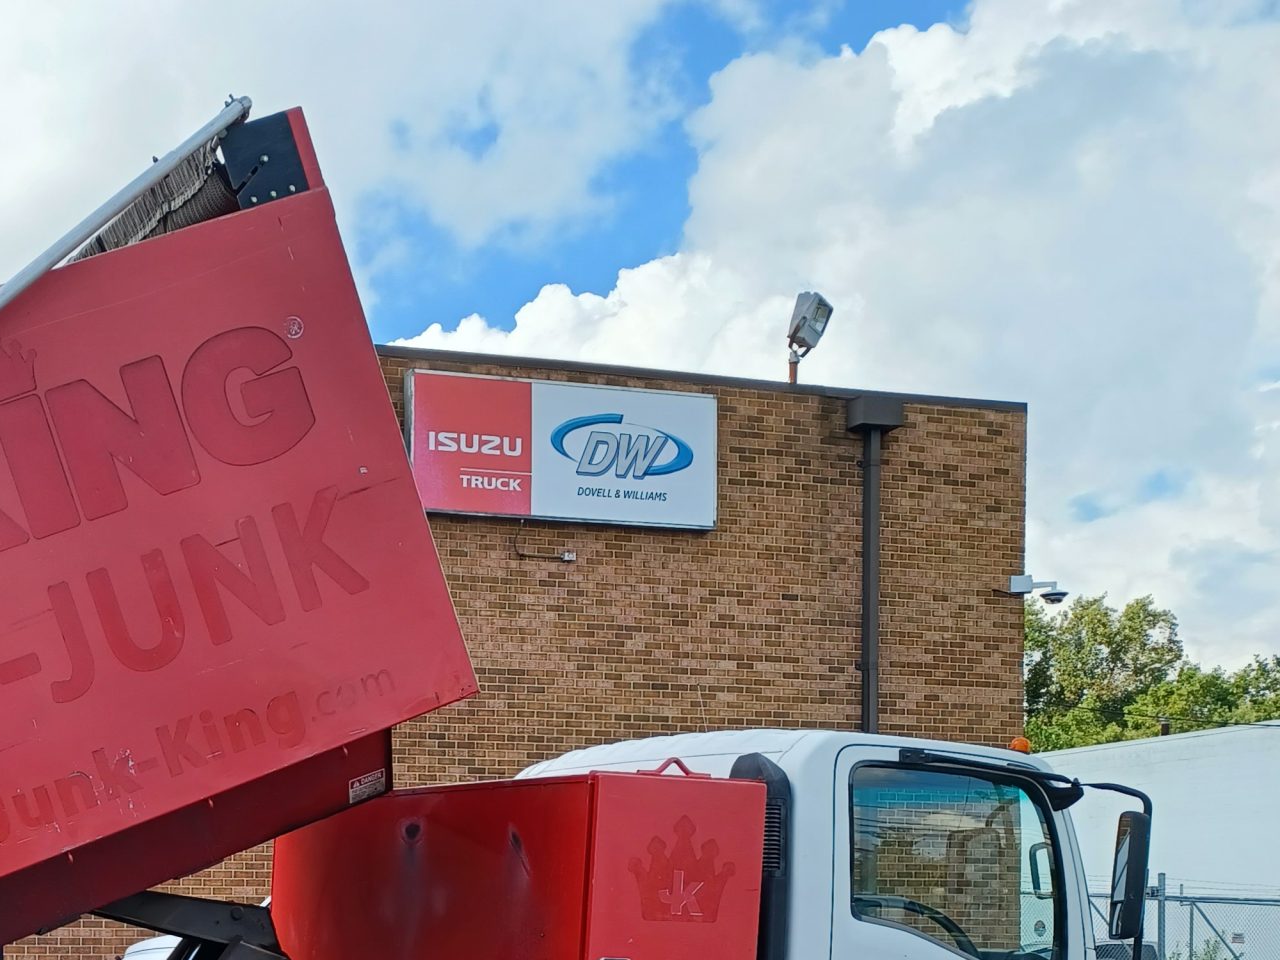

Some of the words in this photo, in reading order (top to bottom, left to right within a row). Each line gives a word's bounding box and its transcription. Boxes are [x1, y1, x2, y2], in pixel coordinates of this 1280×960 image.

[428, 431, 522, 457] ISUZU
[575, 430, 669, 480] DW
[459, 475, 522, 491] TRUCK
[577, 486, 613, 499] DOVELL
[614, 489, 622, 500] &
[622, 490, 668, 502] WILLIAMS
[360, 772, 382, 785] DANGER
